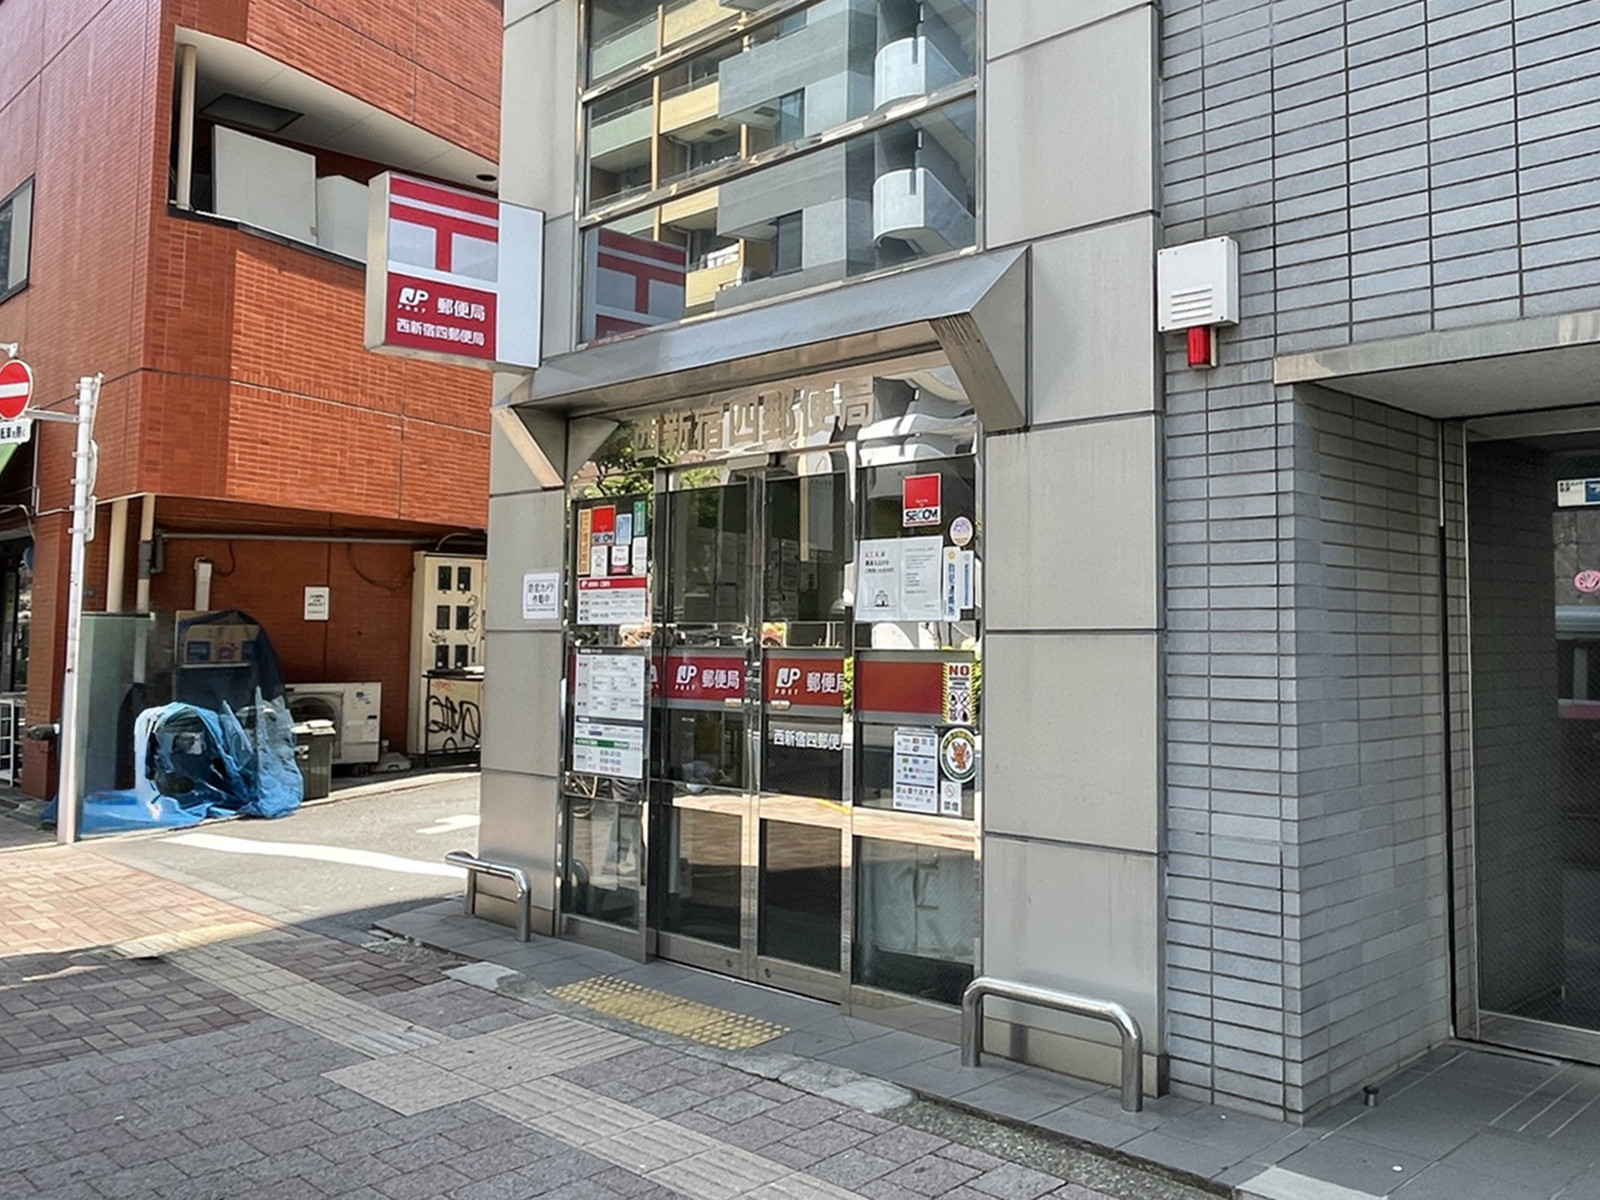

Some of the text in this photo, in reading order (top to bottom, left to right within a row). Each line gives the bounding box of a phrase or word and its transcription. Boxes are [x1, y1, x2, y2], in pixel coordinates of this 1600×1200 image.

[399, 287, 429, 306] JP
[437, 297, 485, 321] 郵便局
[396, 318, 485, 346] 西新宿四郵便局
[634, 378, 874, 460] 西新宿四郵便局
[905, 508, 939, 522] SECOM
[676, 665, 698, 684] JP
[702, 669, 740, 690] 郵便局
[776, 667, 801, 687] JP
[949, 665, 970, 676] NO
[773, 729, 843, 750] 西新宿四郵便
